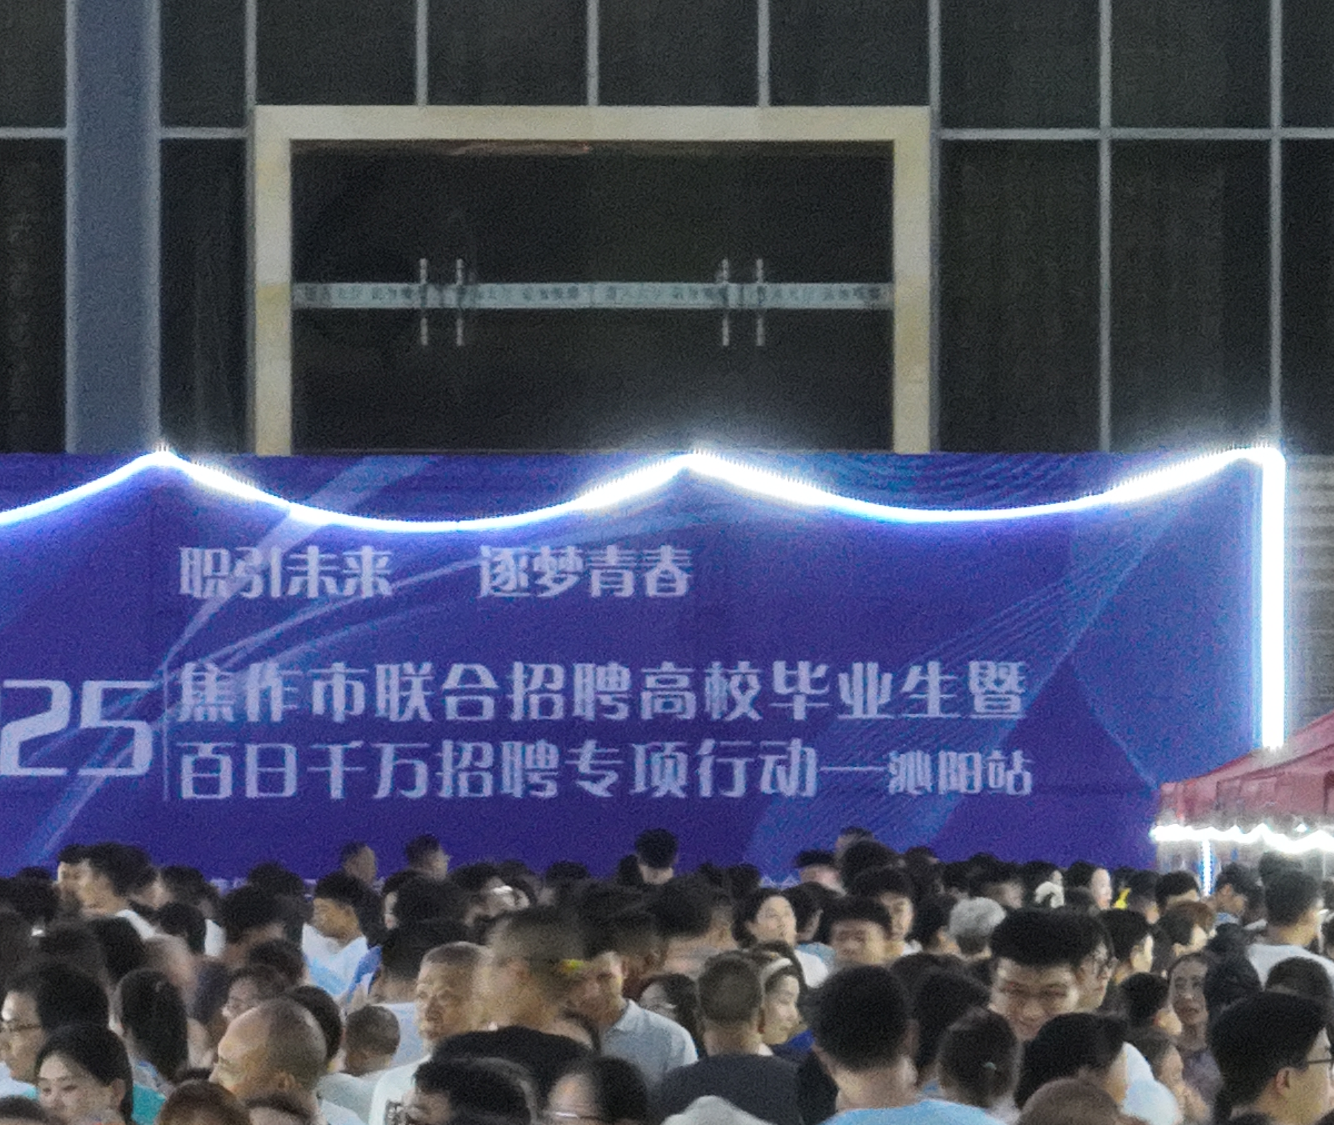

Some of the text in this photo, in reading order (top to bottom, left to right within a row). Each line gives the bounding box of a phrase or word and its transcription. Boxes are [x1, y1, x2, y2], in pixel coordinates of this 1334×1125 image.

[179, 545, 694, 599] 职引未来 逐梦青春
[176, 660, 1027, 723] 焦作市联合招聘高校毕业生暨
